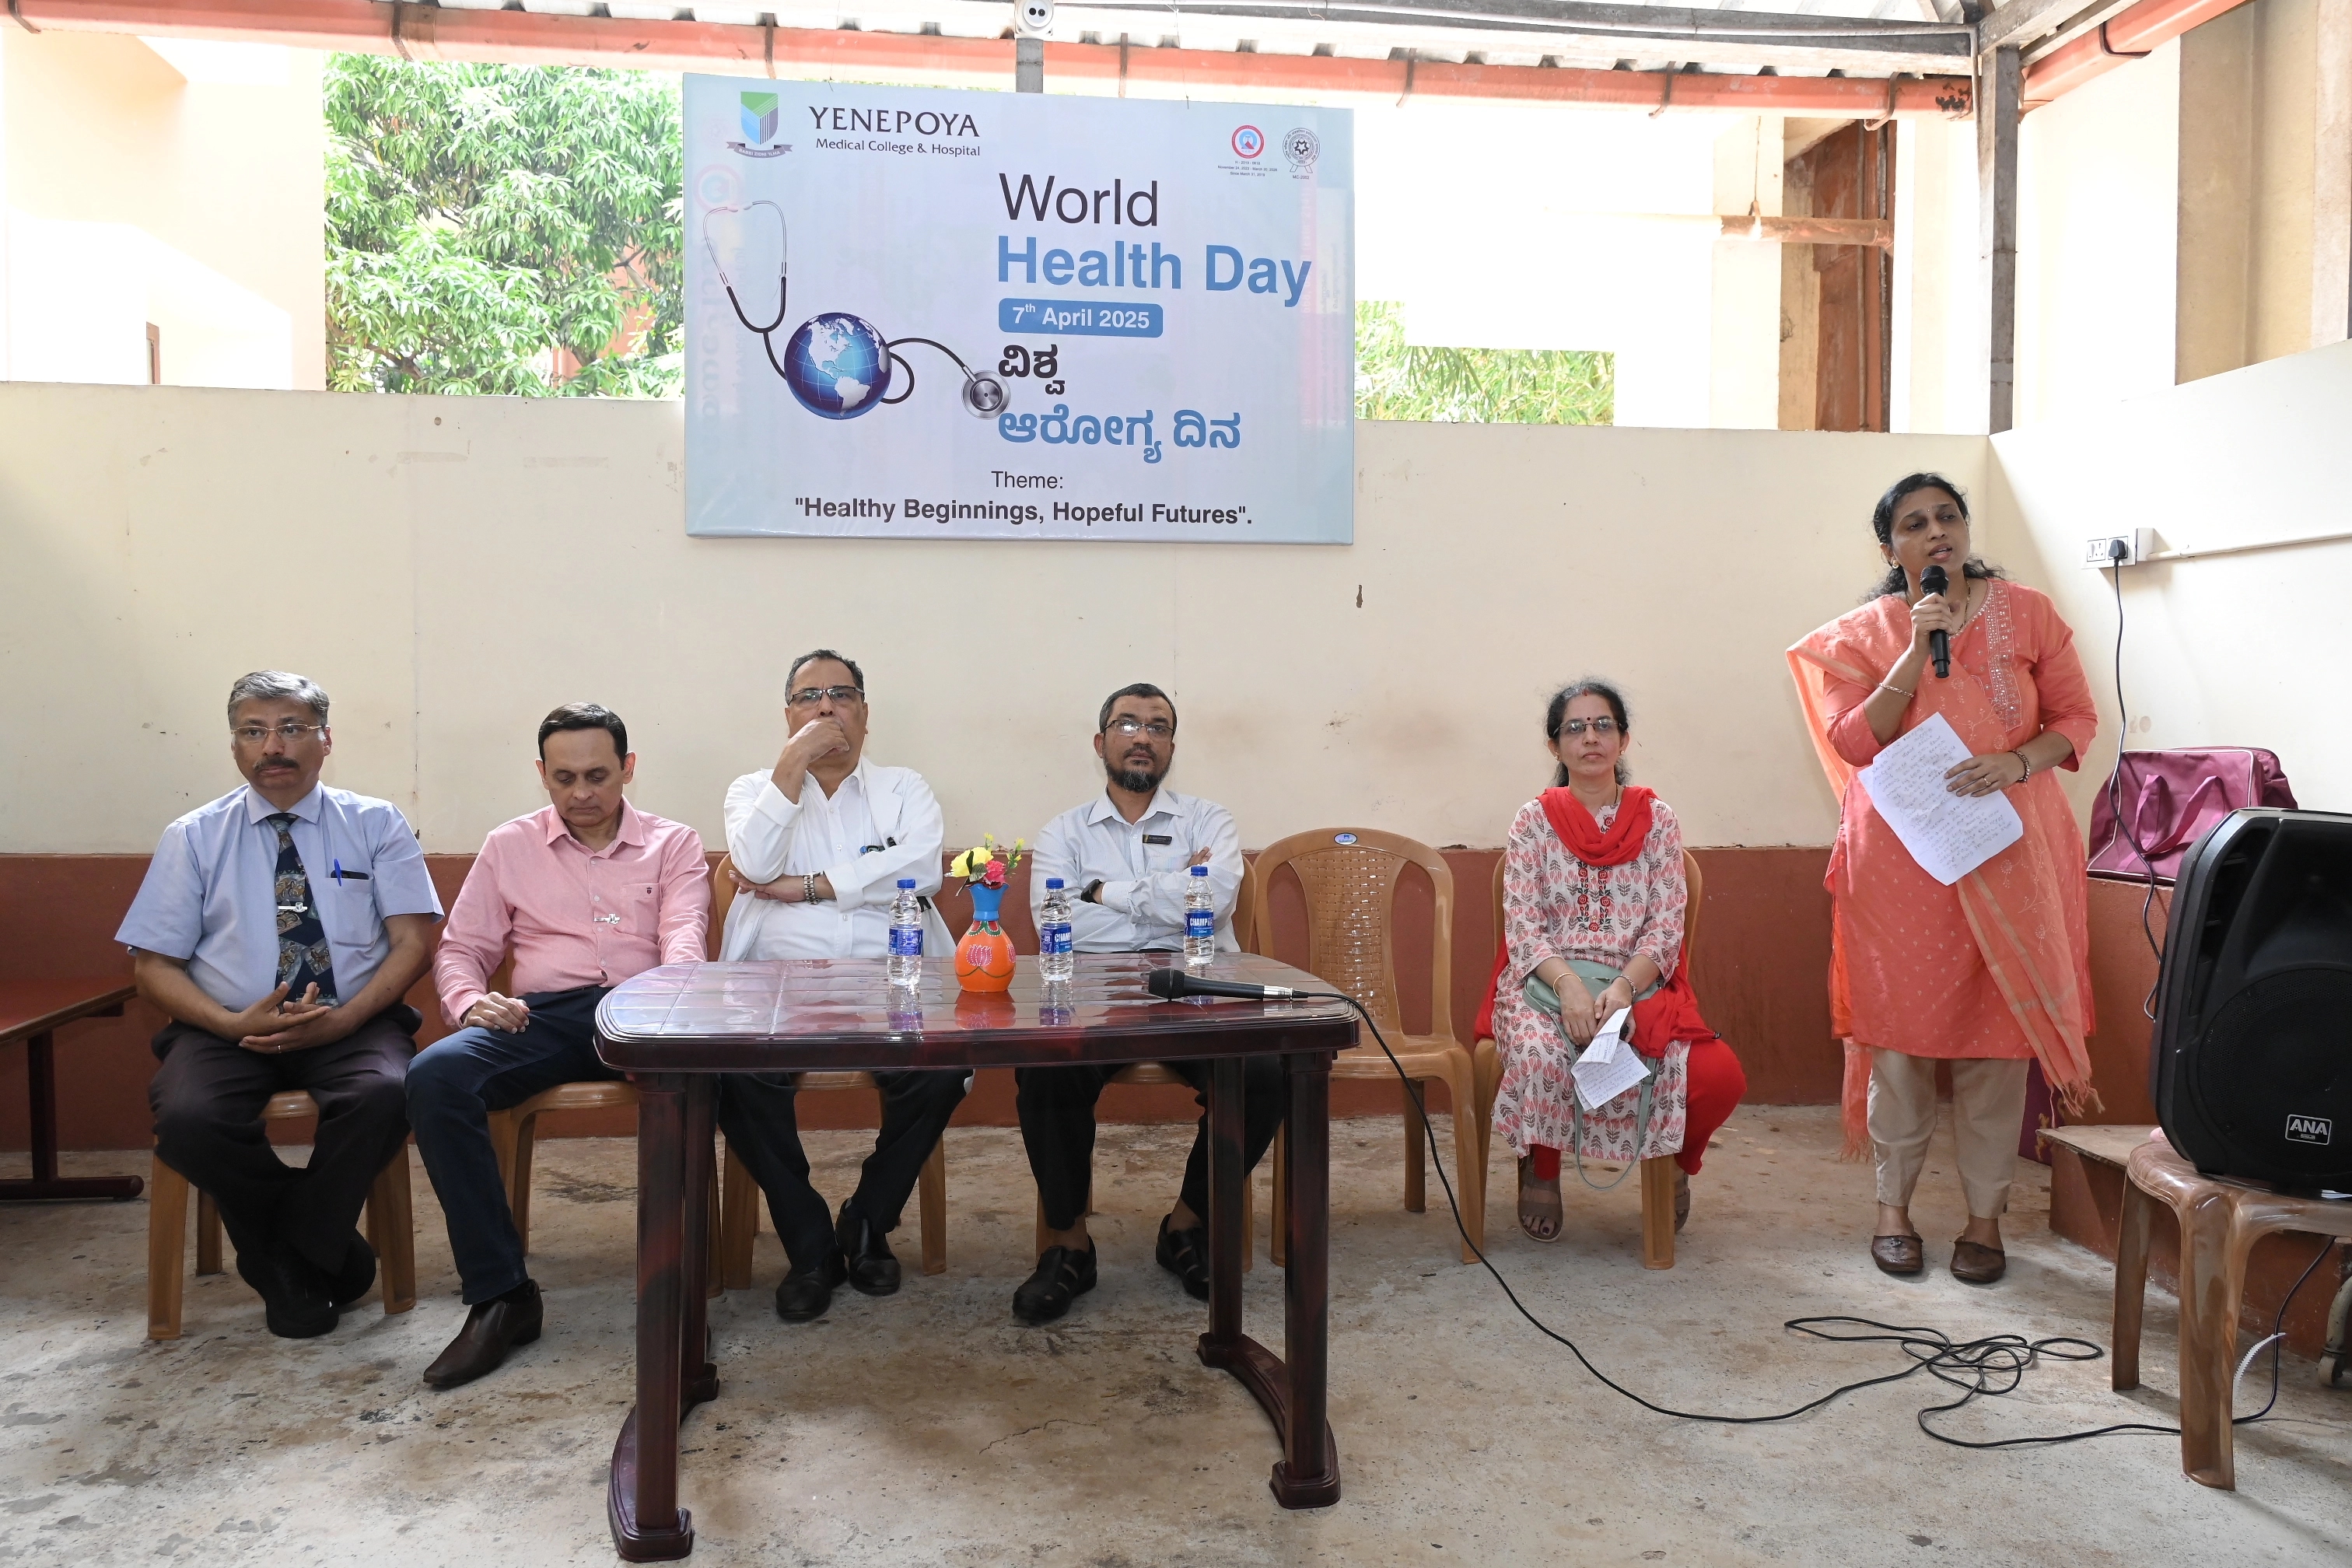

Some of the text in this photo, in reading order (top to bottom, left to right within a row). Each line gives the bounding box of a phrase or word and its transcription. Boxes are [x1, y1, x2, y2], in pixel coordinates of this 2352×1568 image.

[808, 106, 980, 138] YENEPOYA
[816, 138, 980, 158] Medical College & Hospital
[999, 173, 1157, 227] World
[998, 235, 1312, 308] Health Day
[1012, 303, 1150, 331] 7th April 2025
[998, 344, 1066, 395] ವಿಶ್ವ
[998, 404, 1241, 464] ಆರೋಗ್ಯ ದಿನ
[991, 471, 1063, 489] Theme:
[795, 497, 1252, 527] "Healthy Beginnings, Hopeful Futures".
[2290, 1119, 2327, 1135] ANA
